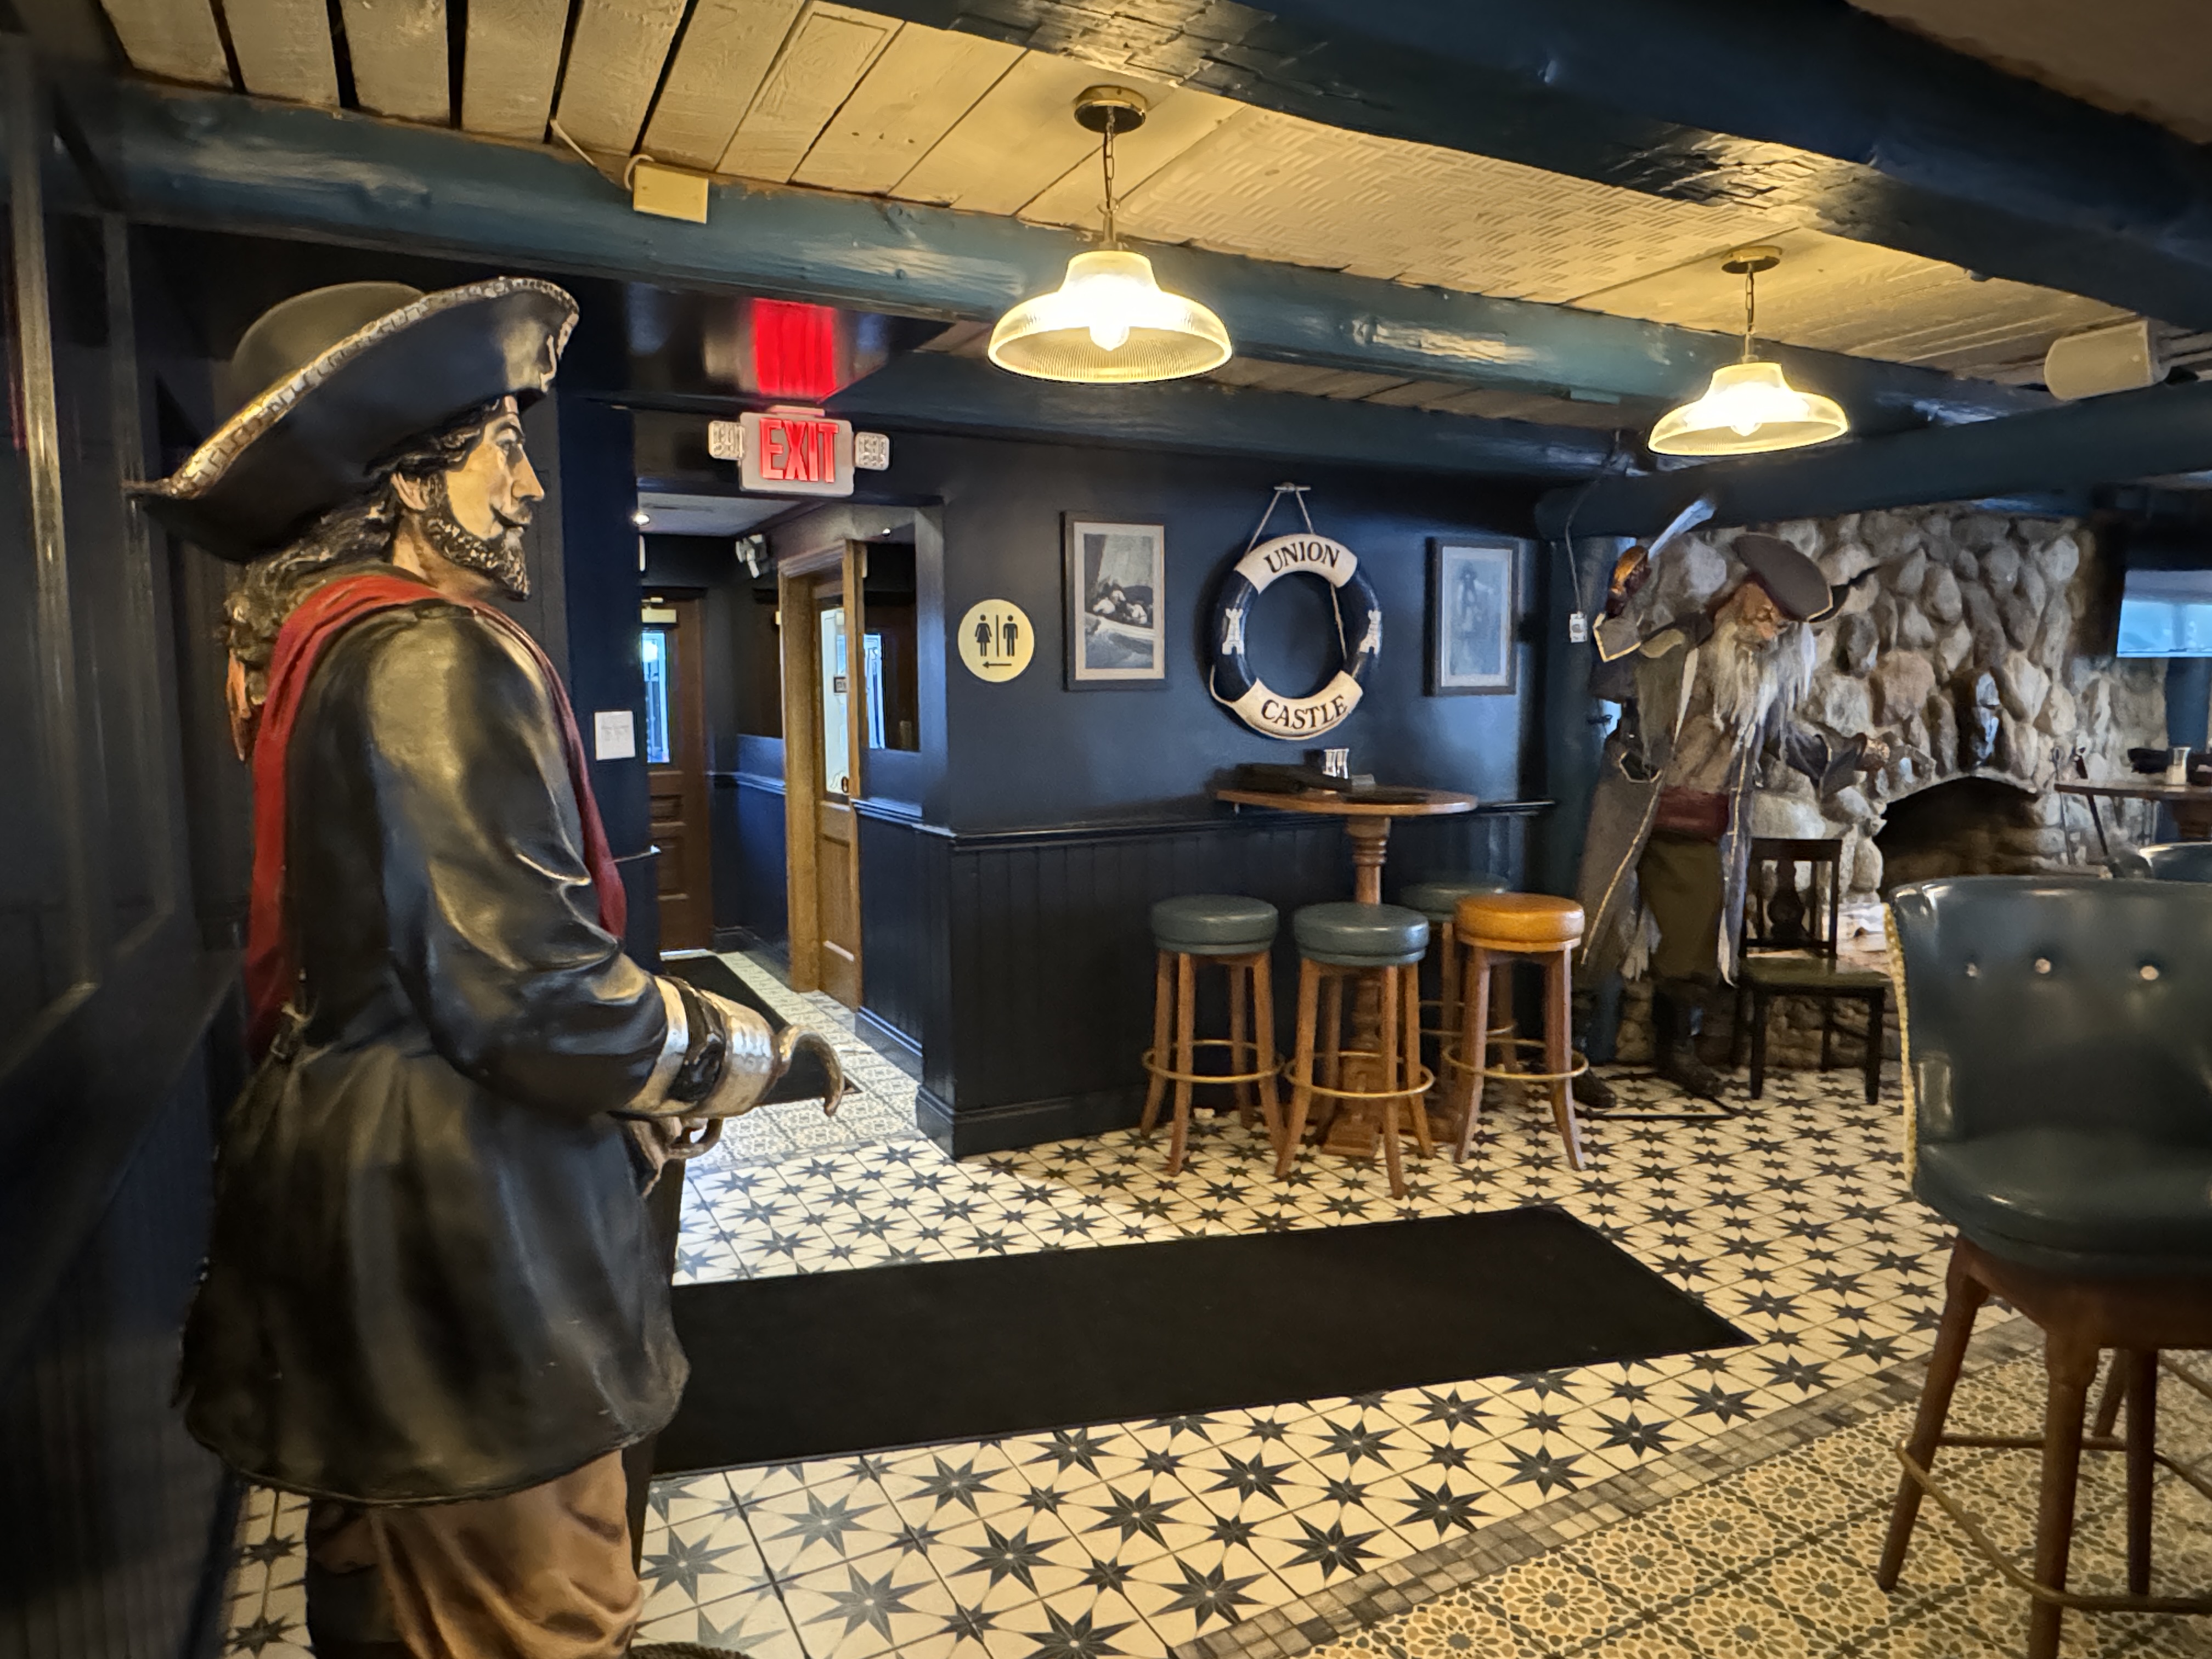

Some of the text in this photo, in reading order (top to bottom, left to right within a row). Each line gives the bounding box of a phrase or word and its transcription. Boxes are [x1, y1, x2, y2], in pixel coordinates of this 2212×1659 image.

[759, 417, 839, 483] EXIT
[1263, 541, 1340, 573] UNION
[1261, 694, 1348, 729] CASTLE
